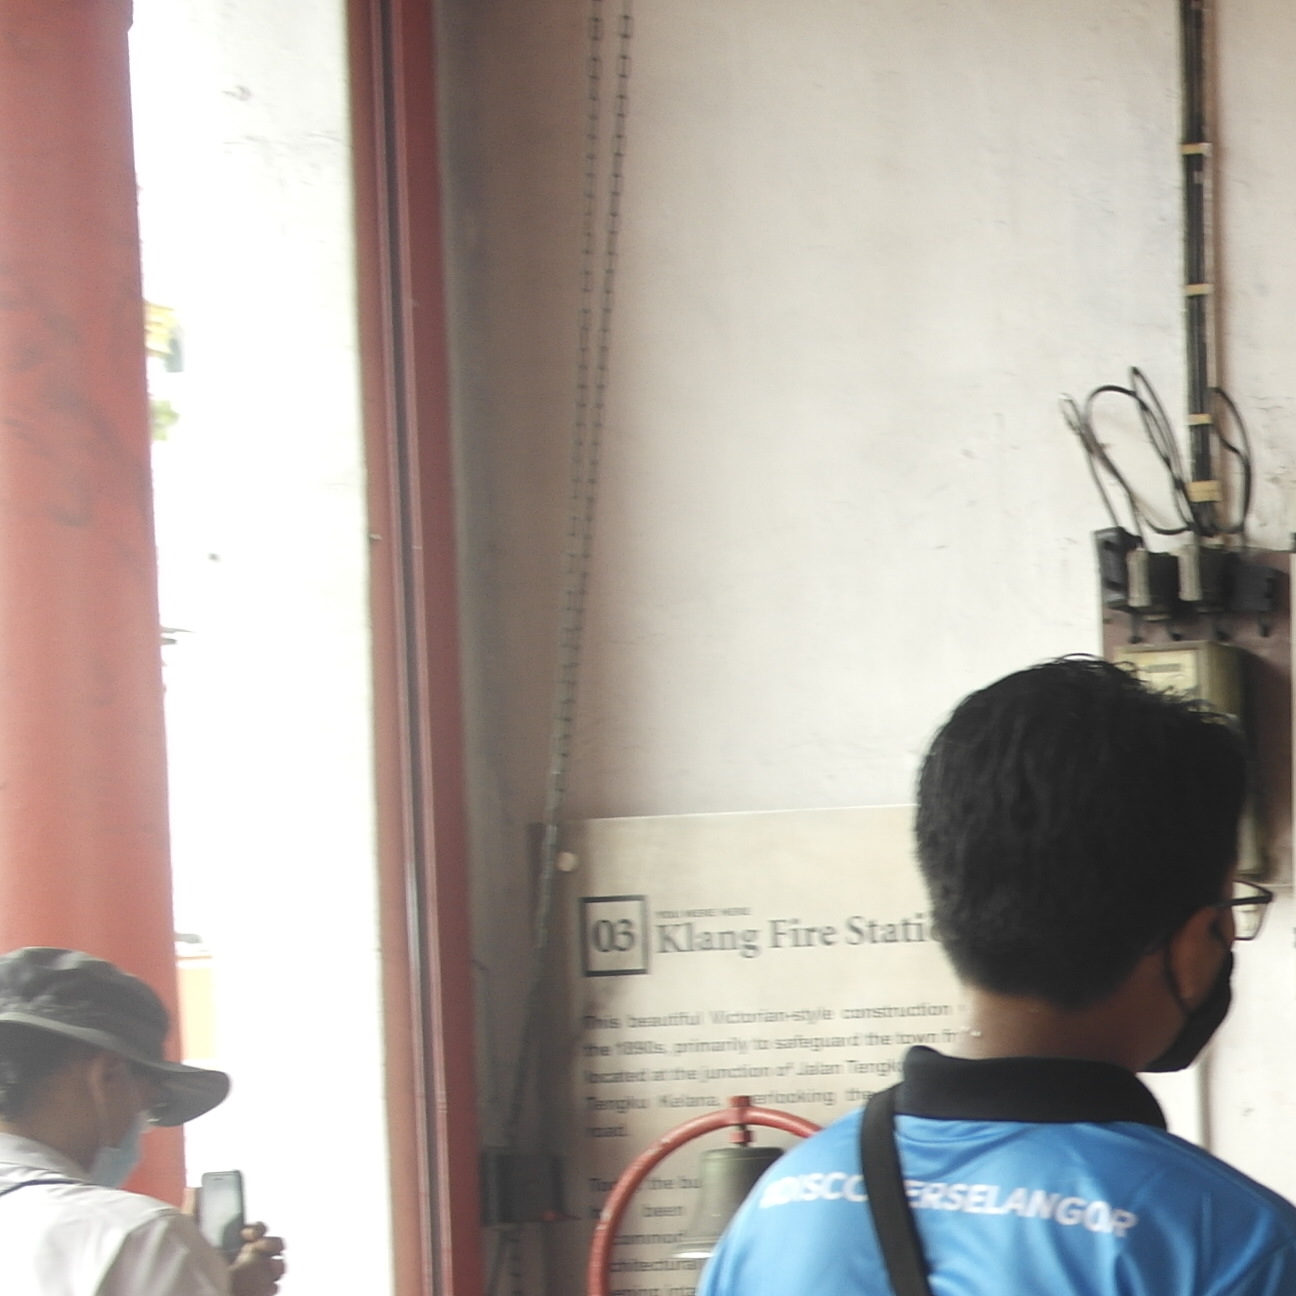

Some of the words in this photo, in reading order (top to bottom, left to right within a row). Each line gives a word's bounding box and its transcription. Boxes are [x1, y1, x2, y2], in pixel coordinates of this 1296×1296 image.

[591, 917, 636, 954] 03
[656, 921, 761, 959] Klang
[769, 918, 837, 949] Fire
[844, 912, 935, 945] Stati
[840, 1003, 952, 1019] construction
[774, 1034, 860, 1052] safeguard
